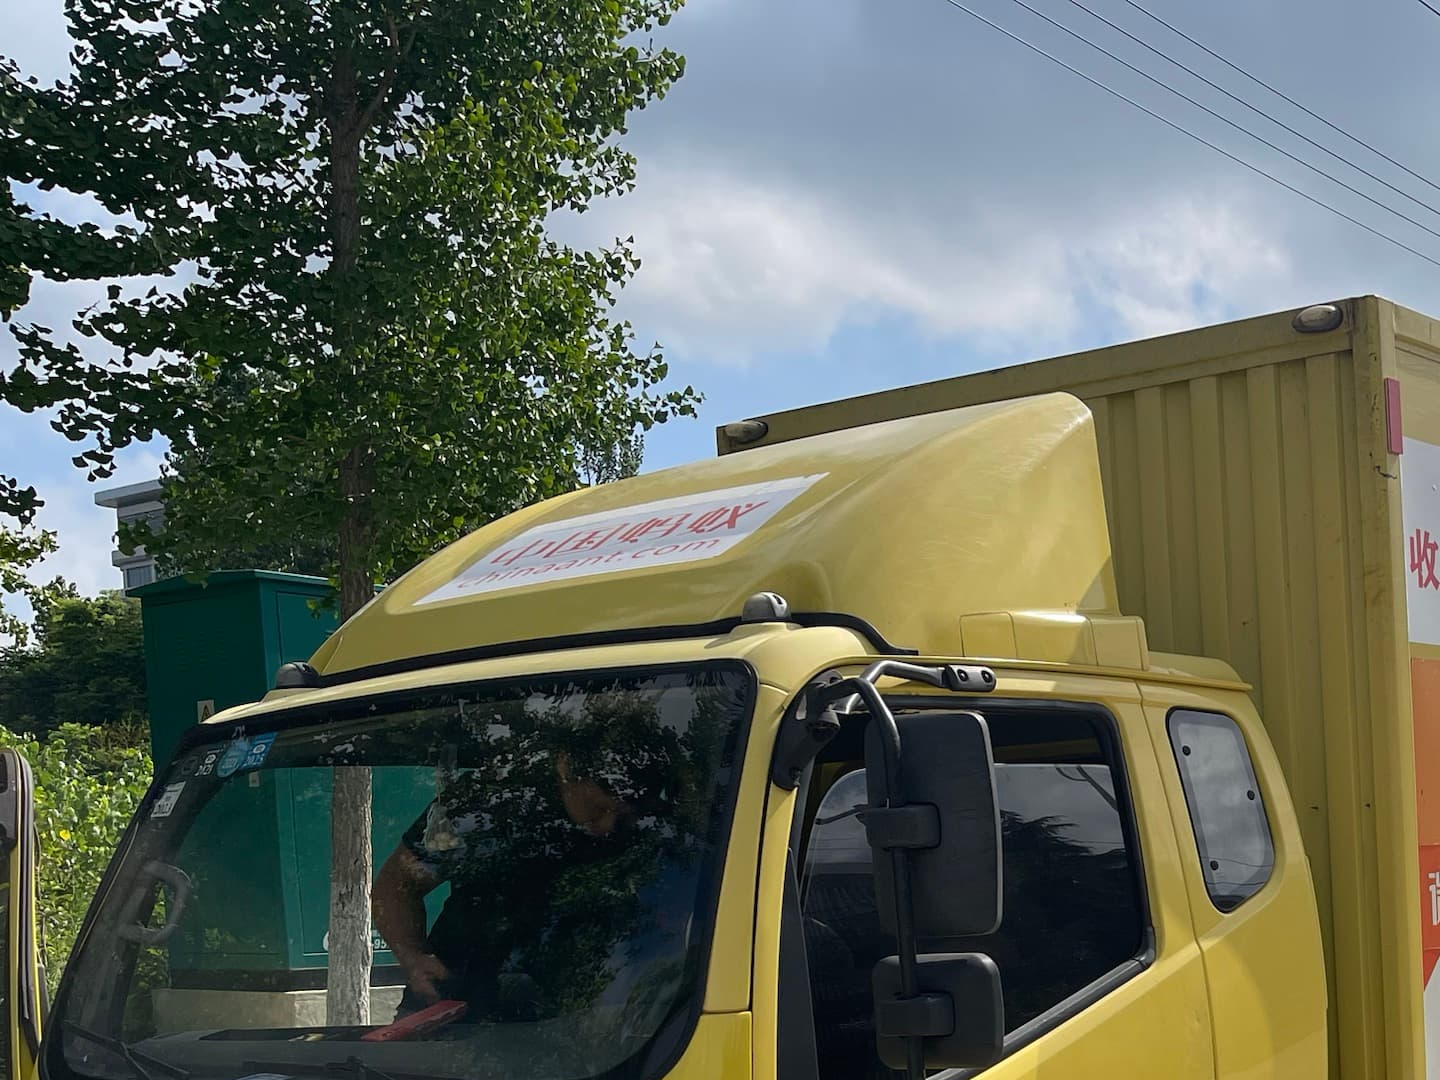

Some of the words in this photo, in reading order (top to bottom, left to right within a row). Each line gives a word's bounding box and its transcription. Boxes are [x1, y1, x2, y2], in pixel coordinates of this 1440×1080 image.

[490, 501, 769, 566] 中国蚂蚁
[457, 538, 721, 588] chinaant.com
